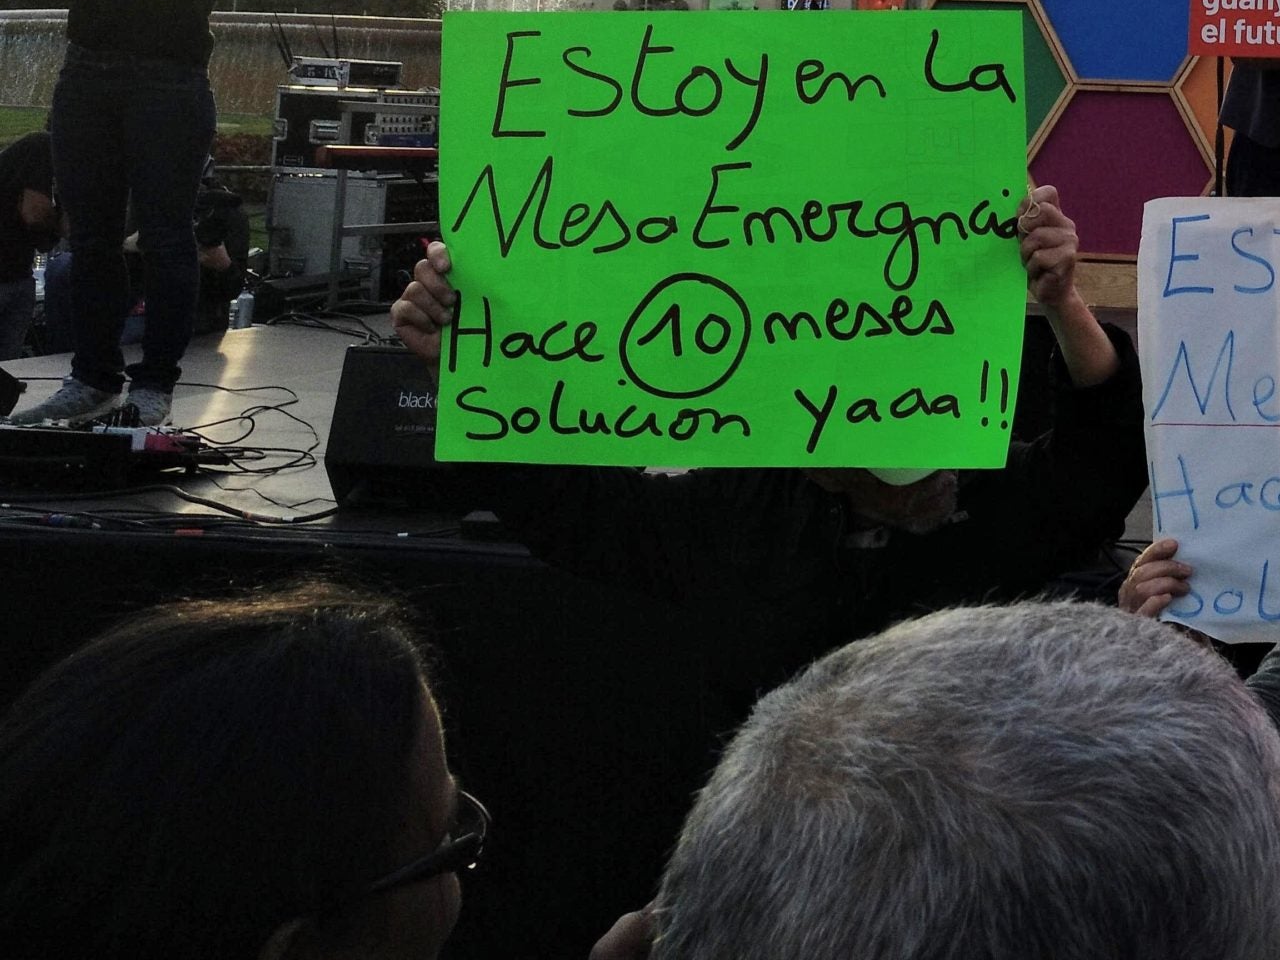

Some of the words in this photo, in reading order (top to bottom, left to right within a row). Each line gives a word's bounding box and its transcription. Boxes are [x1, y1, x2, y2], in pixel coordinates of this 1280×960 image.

[1202, 19, 1225, 44] el
[795, 59, 887, 105] en
[451, 155, 678, 258] Mesa
[447, 290, 605, 373] Hace
[637, 303, 731, 357] 10
[764, 295, 955, 345] meses
[398, 391, 433, 410] black
